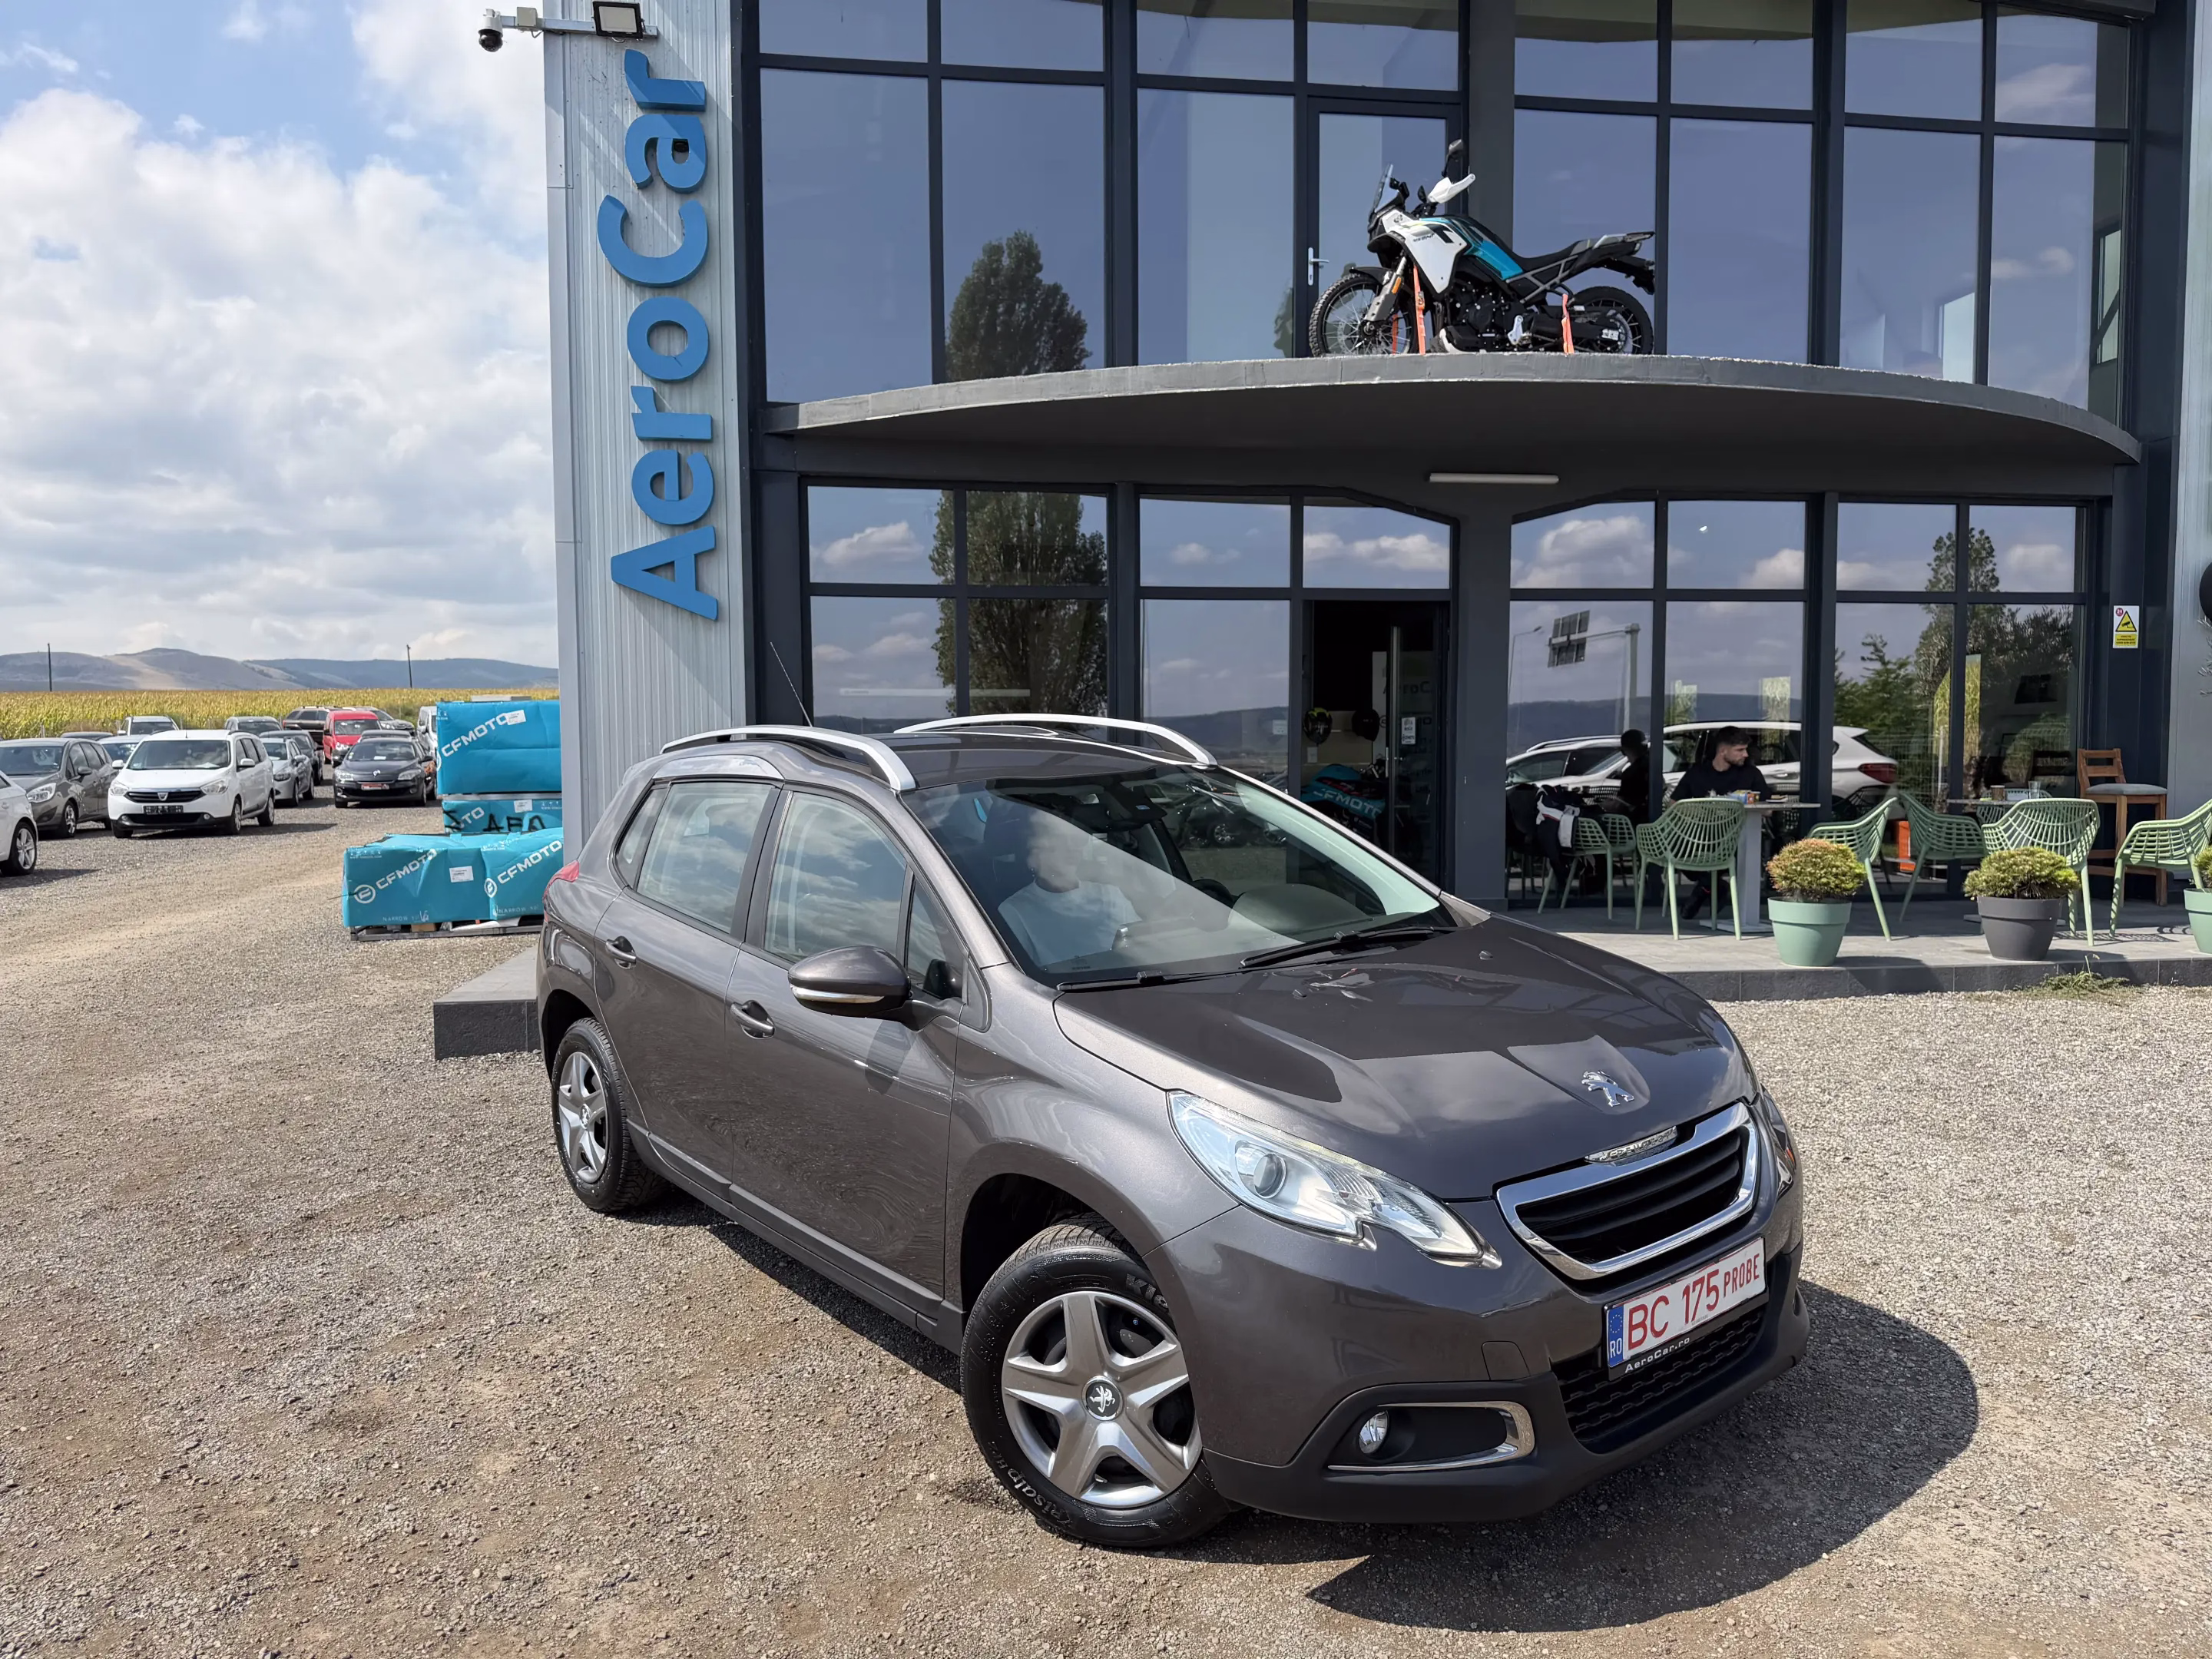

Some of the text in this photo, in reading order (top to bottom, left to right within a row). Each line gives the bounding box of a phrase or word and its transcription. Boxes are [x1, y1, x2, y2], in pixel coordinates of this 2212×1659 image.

[598, 48, 718, 620] AeroCar
[441, 713, 508, 757] CFMOTO
[376, 848, 438, 890] CFMOTO
[498, 840, 563, 884] CFMOTO
[1628, 1253, 1760, 1351] BC 175 PROBE
[1610, 1337, 1623, 1359] RO
[1624, 1337, 1690, 1373] AeroCar.ro
